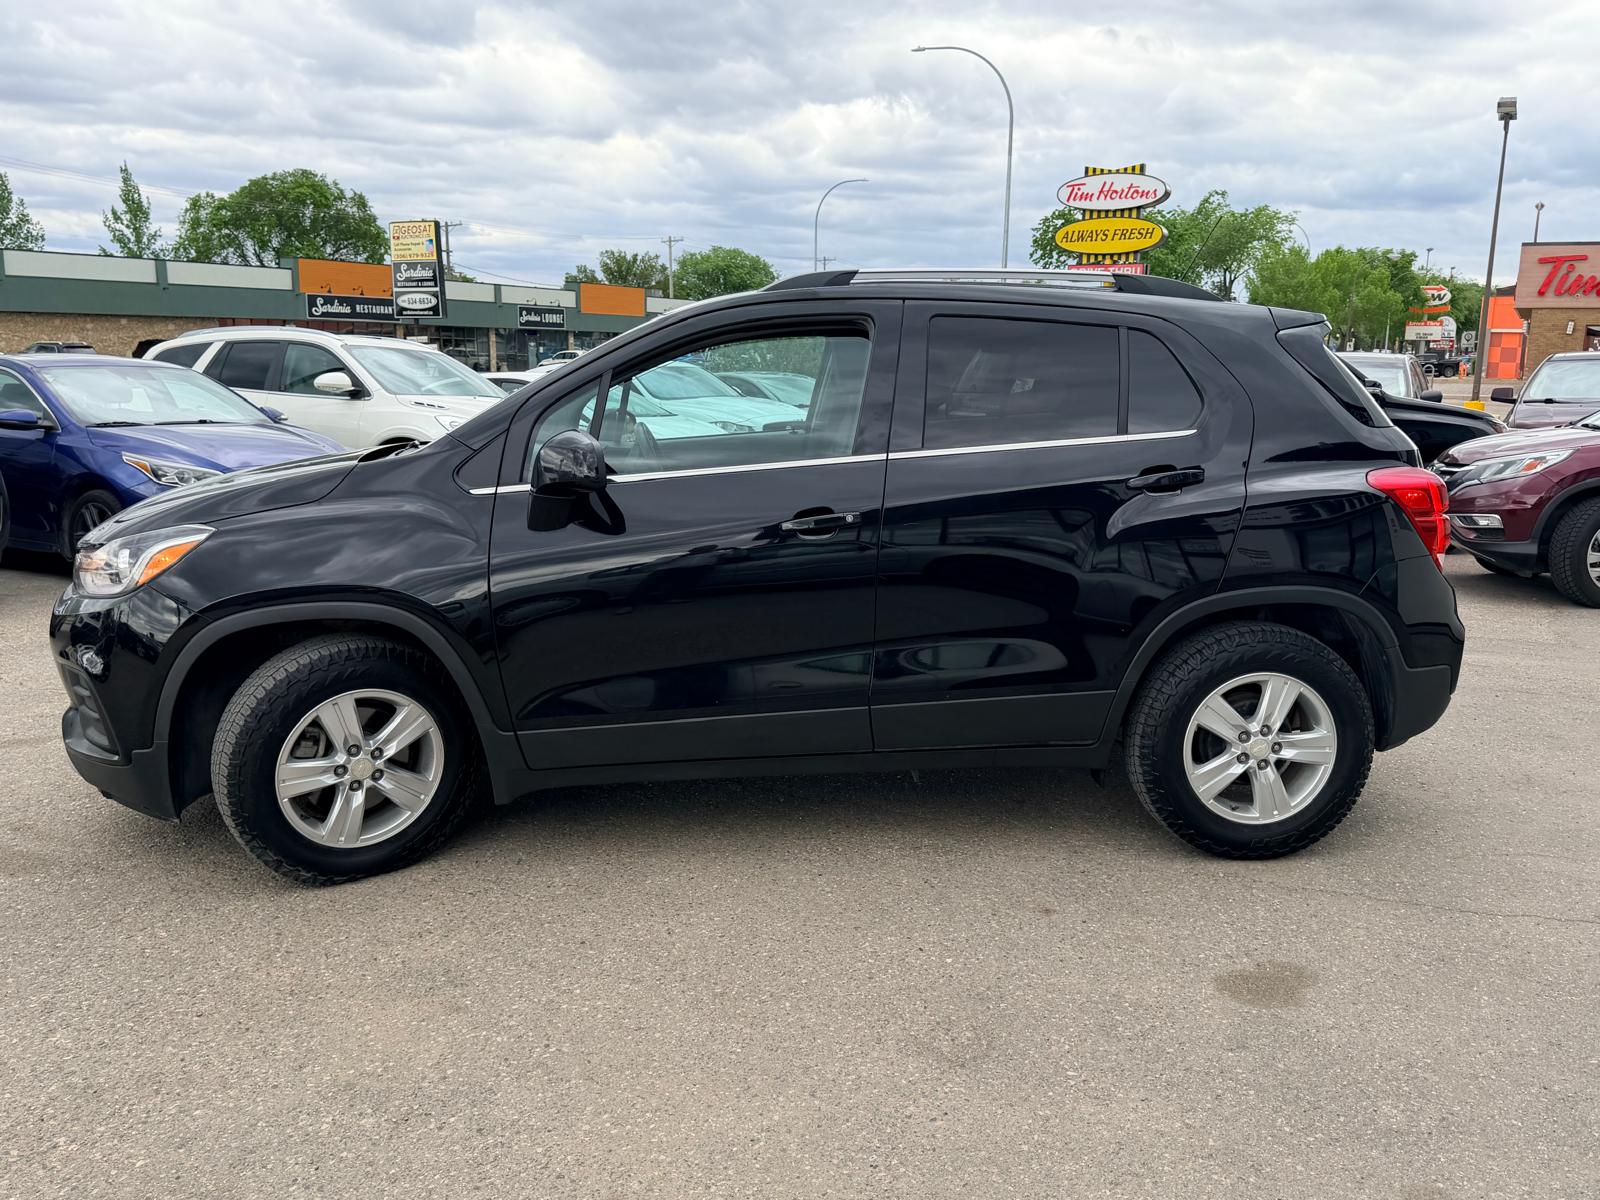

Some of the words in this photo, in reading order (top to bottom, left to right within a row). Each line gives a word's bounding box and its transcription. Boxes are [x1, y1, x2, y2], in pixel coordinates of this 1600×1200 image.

[1066, 183, 1095, 203] Tim
[1096, 181, 1158, 201] Hortons
[400, 224, 432, 234] GEOSAT
[1060, 229, 1110, 243] ALWAYS
[1111, 227, 1155, 241] FRESH
[396, 263, 434, 281] Sardinia
[1538, 255, 1600, 297] Tim
[311, 297, 352, 316] Sardinia
[542, 313, 564, 324] LOUNGE
